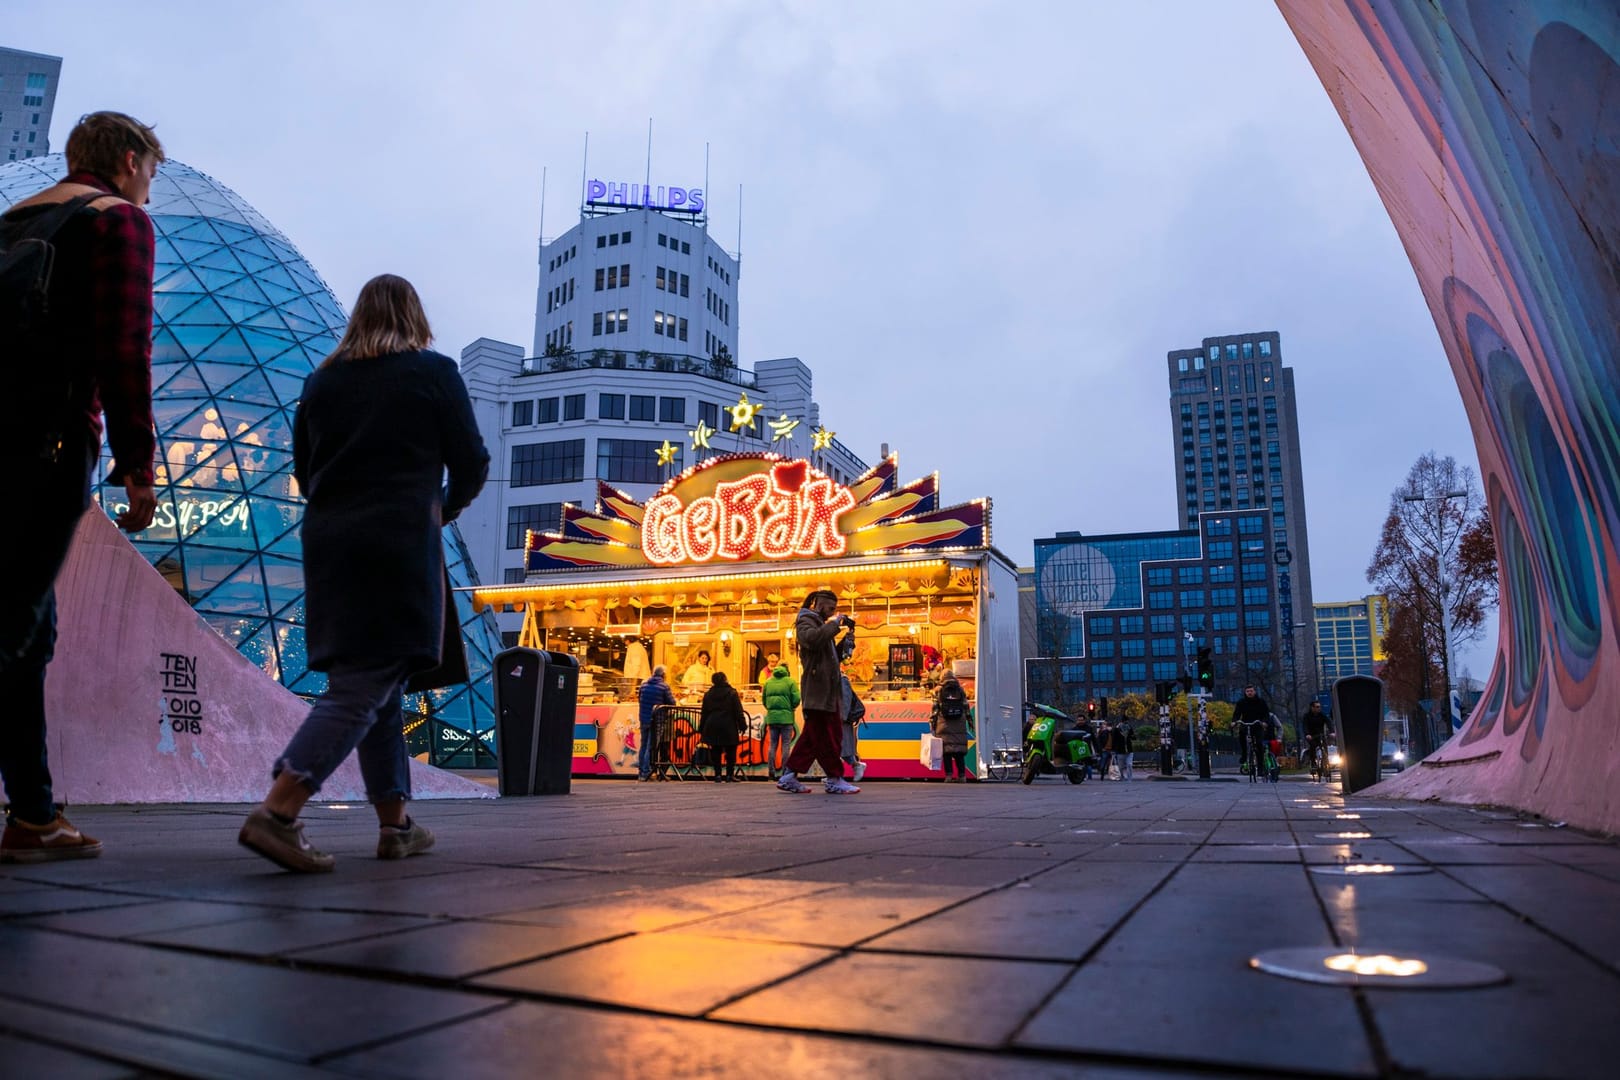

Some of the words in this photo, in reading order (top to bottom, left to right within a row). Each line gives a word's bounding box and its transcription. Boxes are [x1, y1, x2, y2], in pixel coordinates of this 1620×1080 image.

[587, 180, 704, 213] PHILIPS
[160, 653, 197, 673] TEN
[160, 671, 196, 689] TEN
